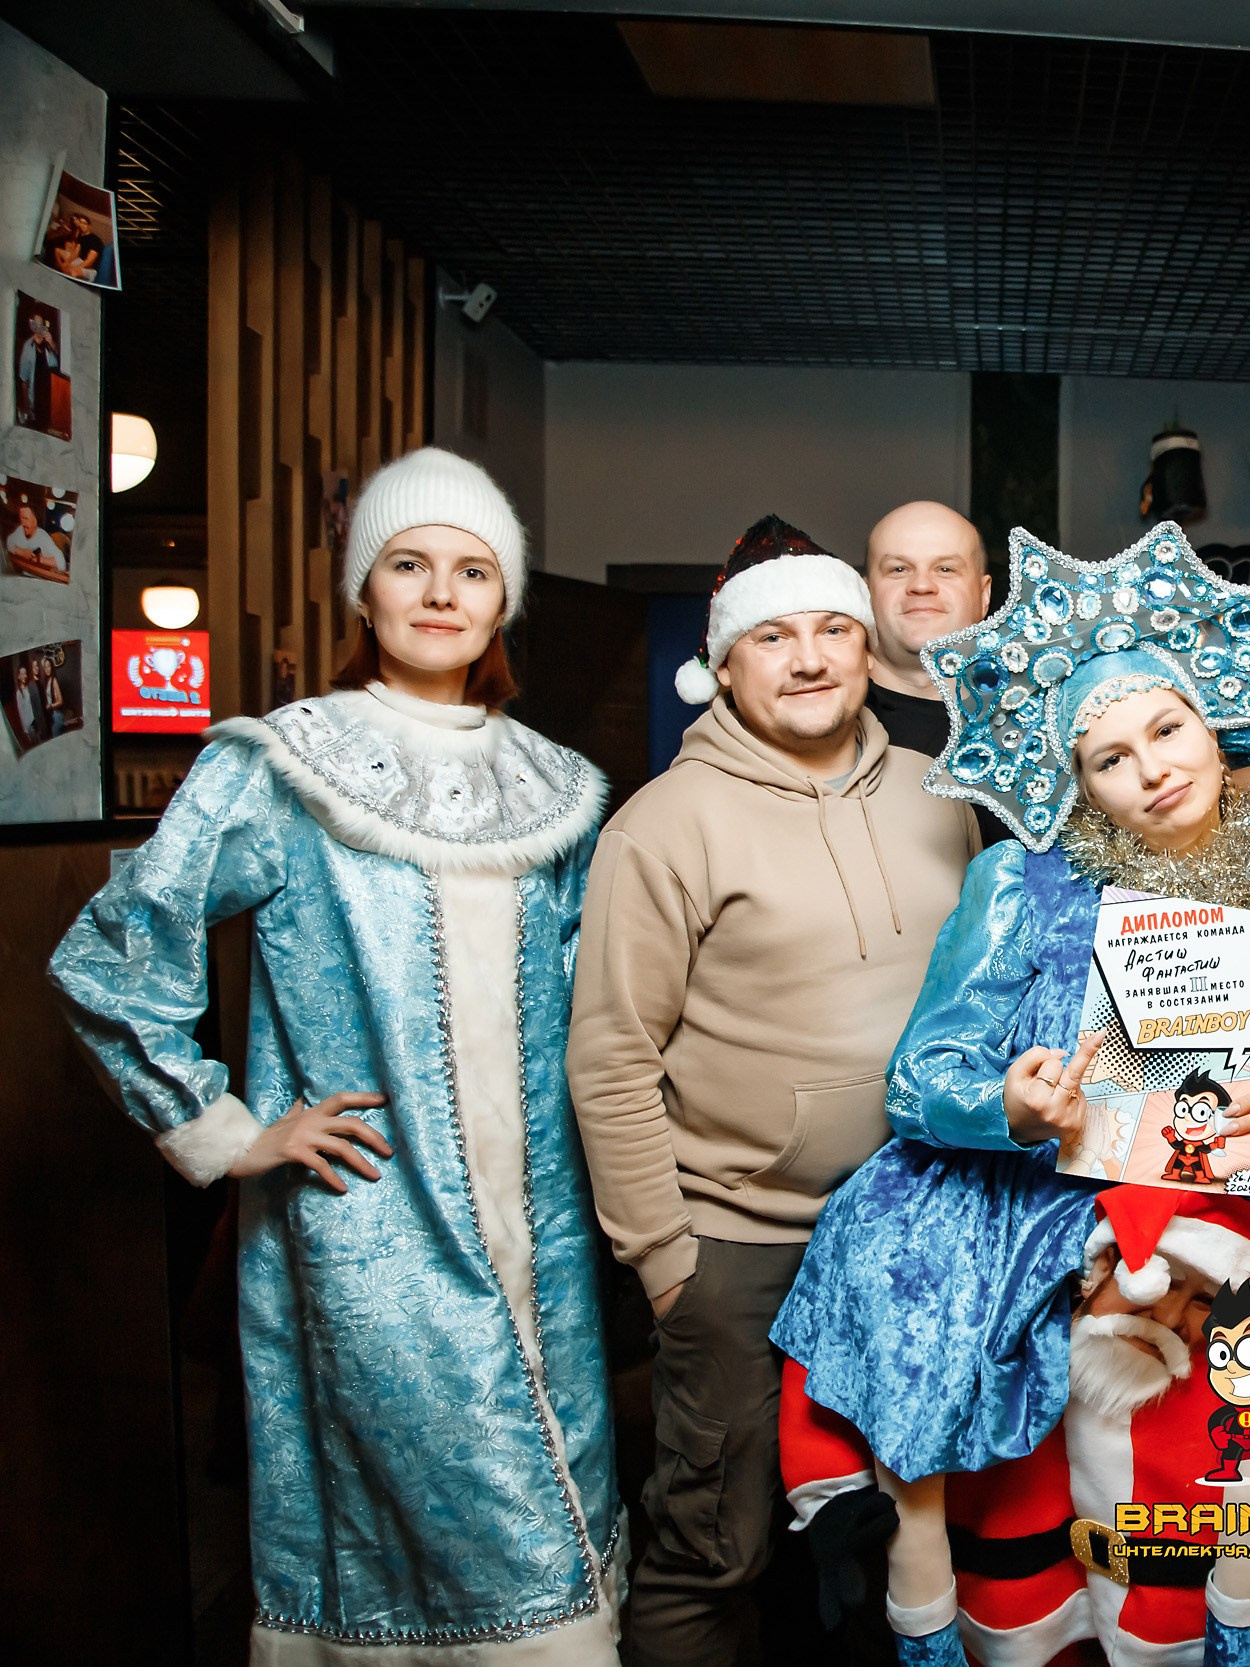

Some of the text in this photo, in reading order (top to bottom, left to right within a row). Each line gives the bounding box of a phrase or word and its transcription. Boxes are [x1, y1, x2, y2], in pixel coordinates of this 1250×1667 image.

[1120, 907, 1224, 936] ДИПЛОМОМ
[1107, 925, 1245, 948] НАГРАЖДАЕТСЯ КОМАНДА
[1125, 984, 1187, 998] ЗАНЯВШАЯ
[1210, 980, 1245, 991] МЕСТО
[1147, 993, 1229, 1009] В СОСТЯЗАНИИ
